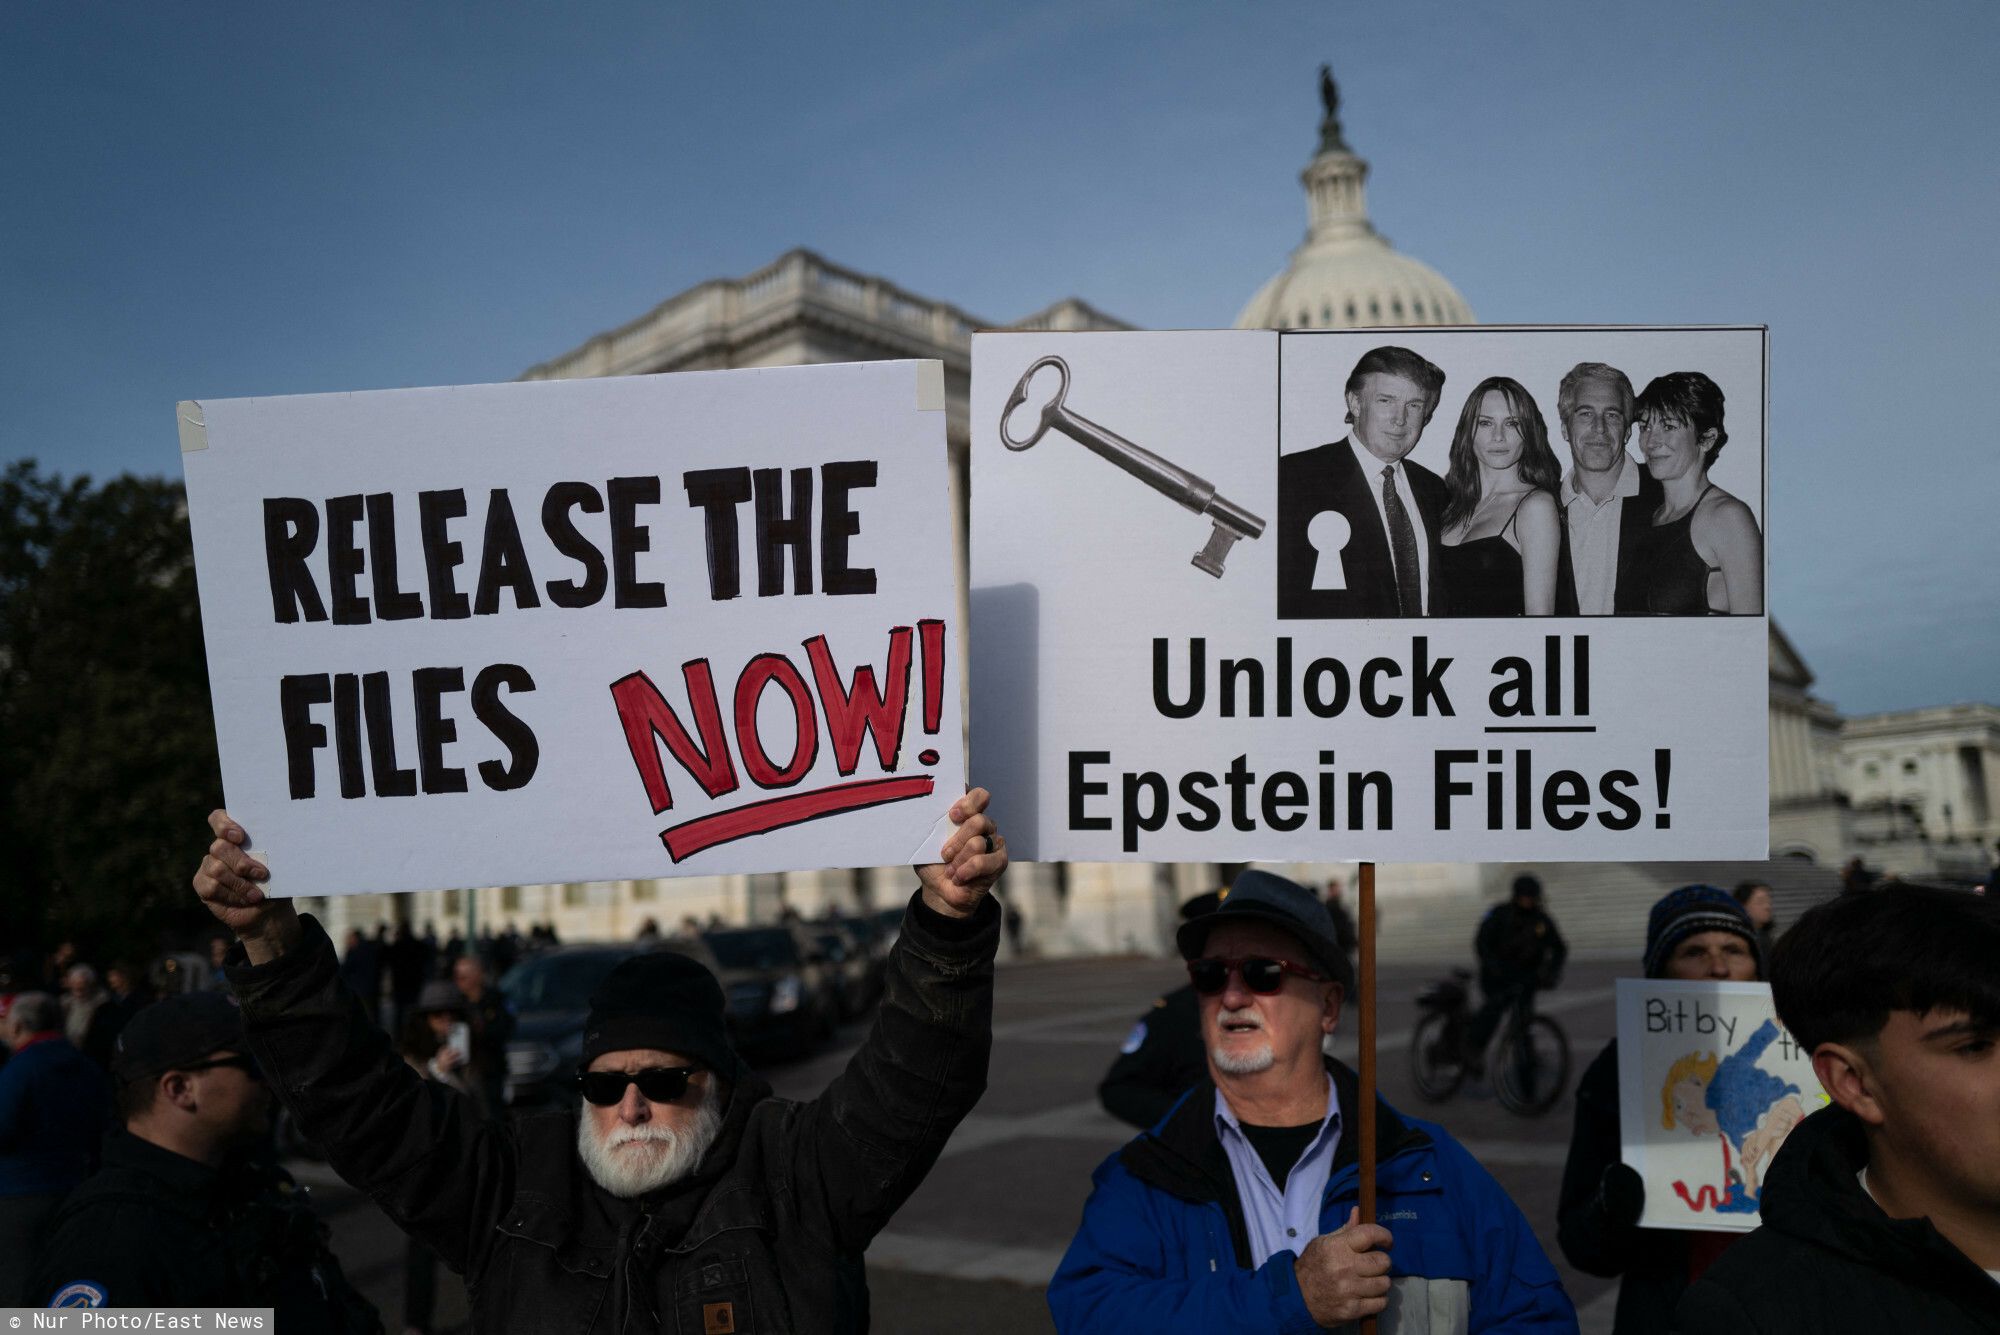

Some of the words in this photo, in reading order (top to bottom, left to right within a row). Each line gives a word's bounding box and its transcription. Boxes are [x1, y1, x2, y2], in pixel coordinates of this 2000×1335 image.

[263, 476, 667, 625] RELEASE
[683, 460, 878, 601] THE
[280, 664, 540, 800] FILES
[609, 619, 946, 815] NOW!
[1152, 636, 1456, 718] Unlock
[1489, 635, 1590, 717] all
[1068, 750, 1393, 852] Epstein
[1434, 749, 1671, 831] Files!
[1646, 999, 1688, 1034] Bit
[1696, 999, 1738, 1046] by
